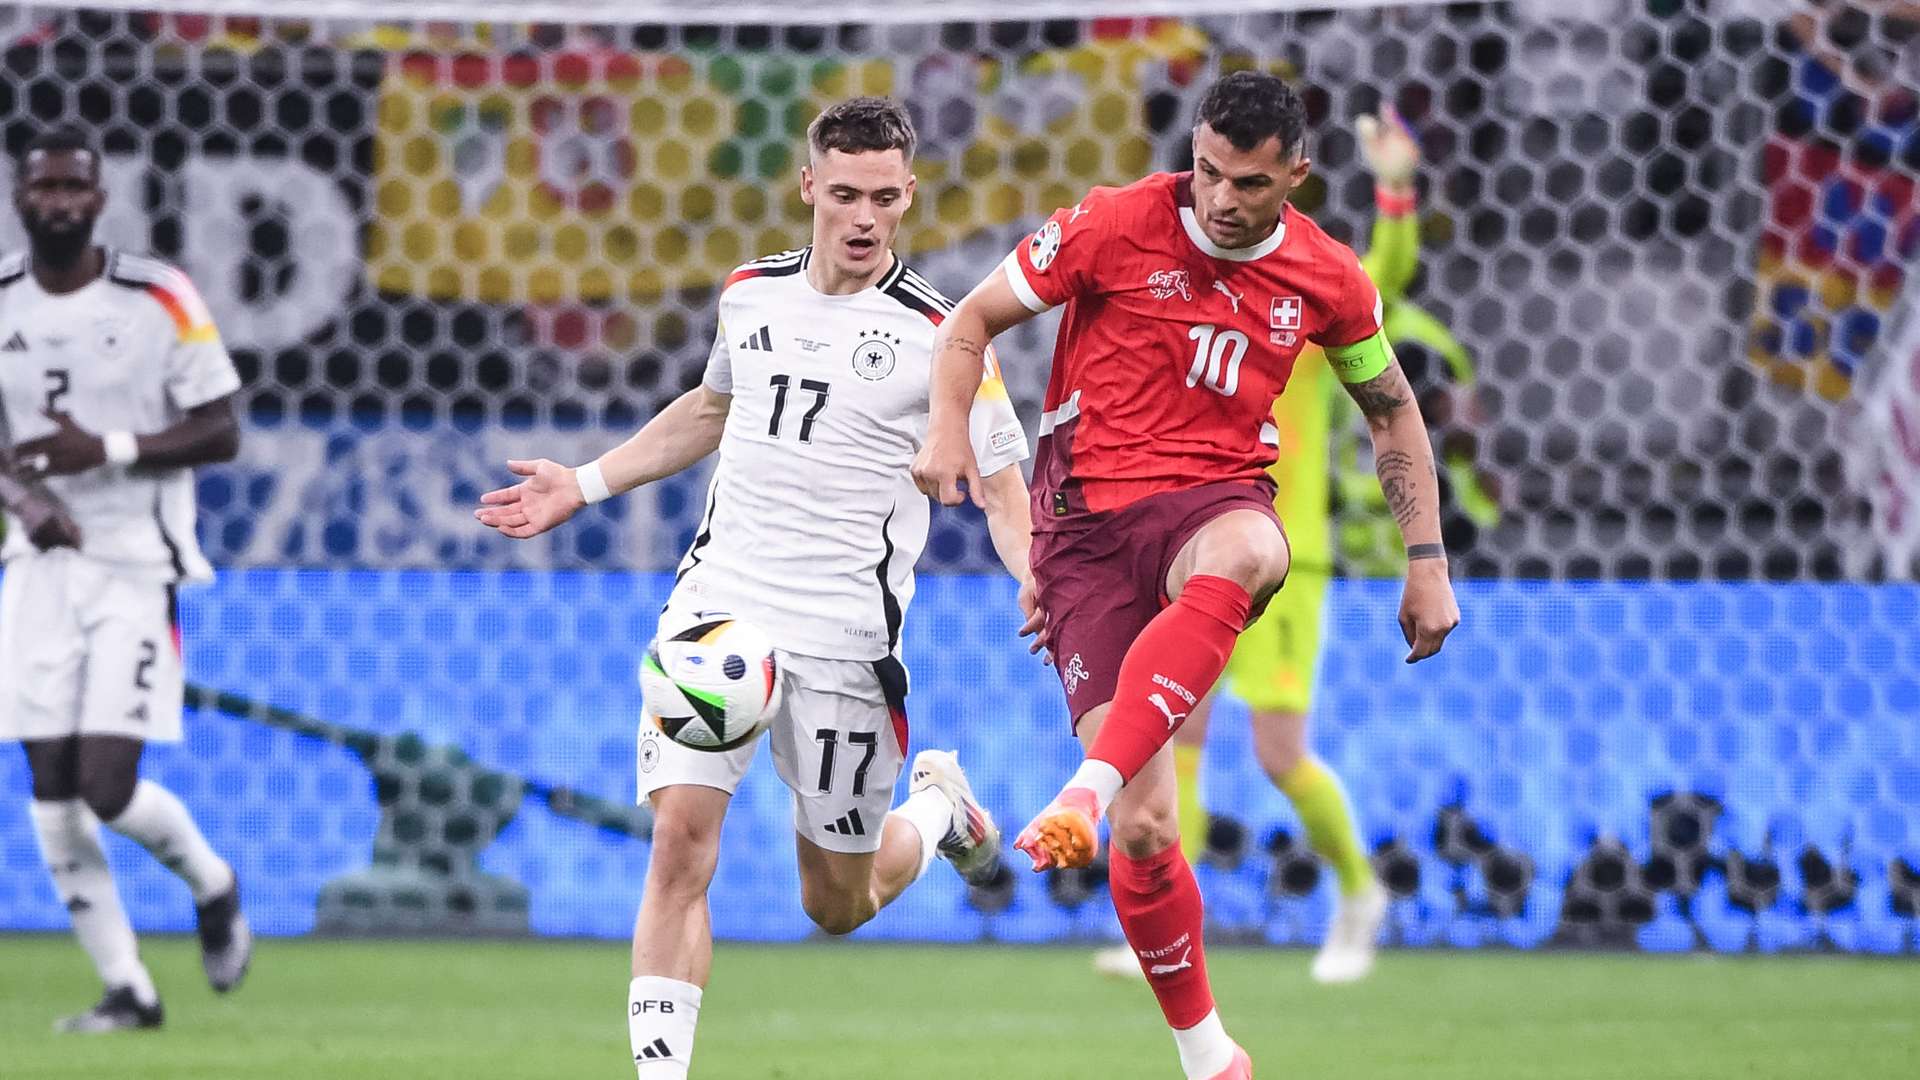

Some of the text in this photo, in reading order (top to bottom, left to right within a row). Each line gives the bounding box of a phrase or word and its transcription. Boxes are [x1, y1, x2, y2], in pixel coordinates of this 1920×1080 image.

[1186, 323, 1249, 397] 10
[44, 368, 71, 417] 2
[768, 373, 832, 445] 17
[135, 639, 156, 690] 2
[1151, 673, 1197, 706] SUISSE
[815, 727, 879, 797] 17
[1139, 932, 1190, 959] SUISSE
[631, 1000, 675, 1017] DFB
